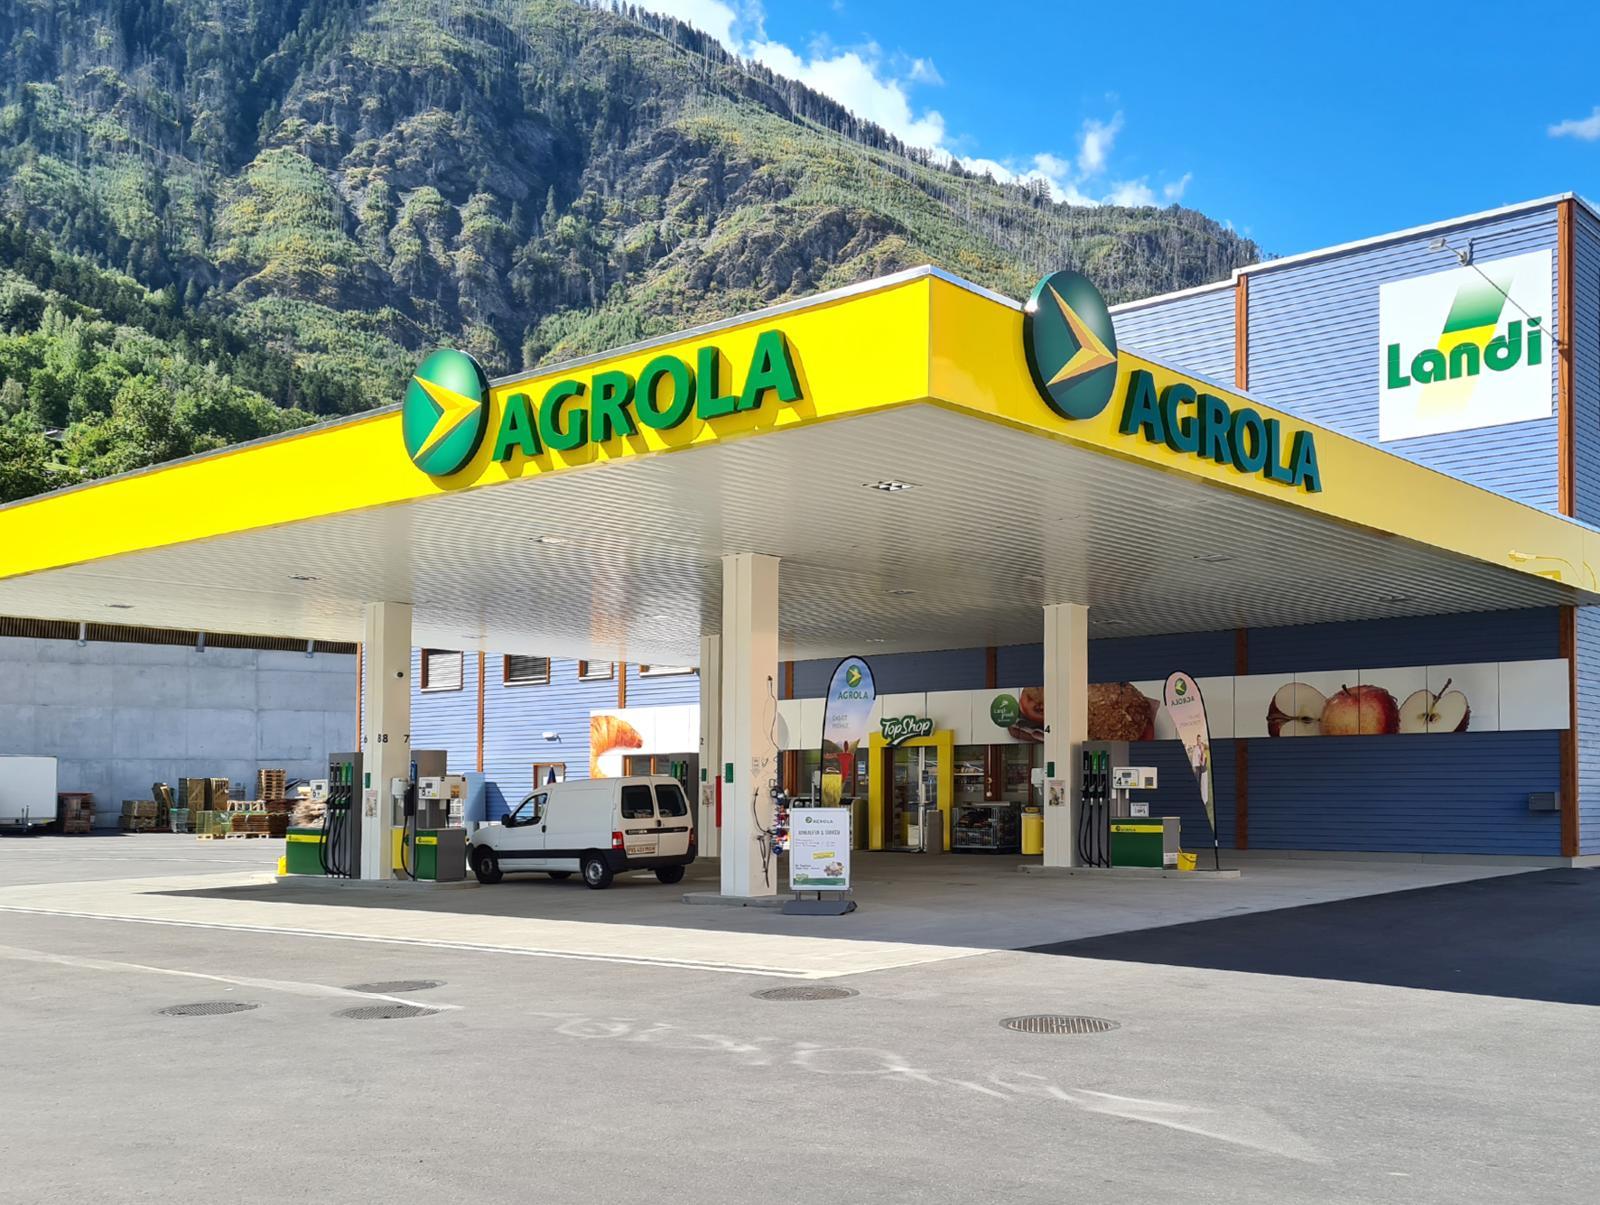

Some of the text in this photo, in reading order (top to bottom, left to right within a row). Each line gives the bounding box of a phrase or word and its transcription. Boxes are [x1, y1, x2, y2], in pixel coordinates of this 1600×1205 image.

[1386, 316, 1543, 390] Landi
[492, 329, 803, 463] AGROLA
[1119, 368, 1323, 494] AGROLA
[837, 690, 869, 701] AGROLA
[404, 735, 410, 743] 7
[1045, 724, 1051, 734] 4
